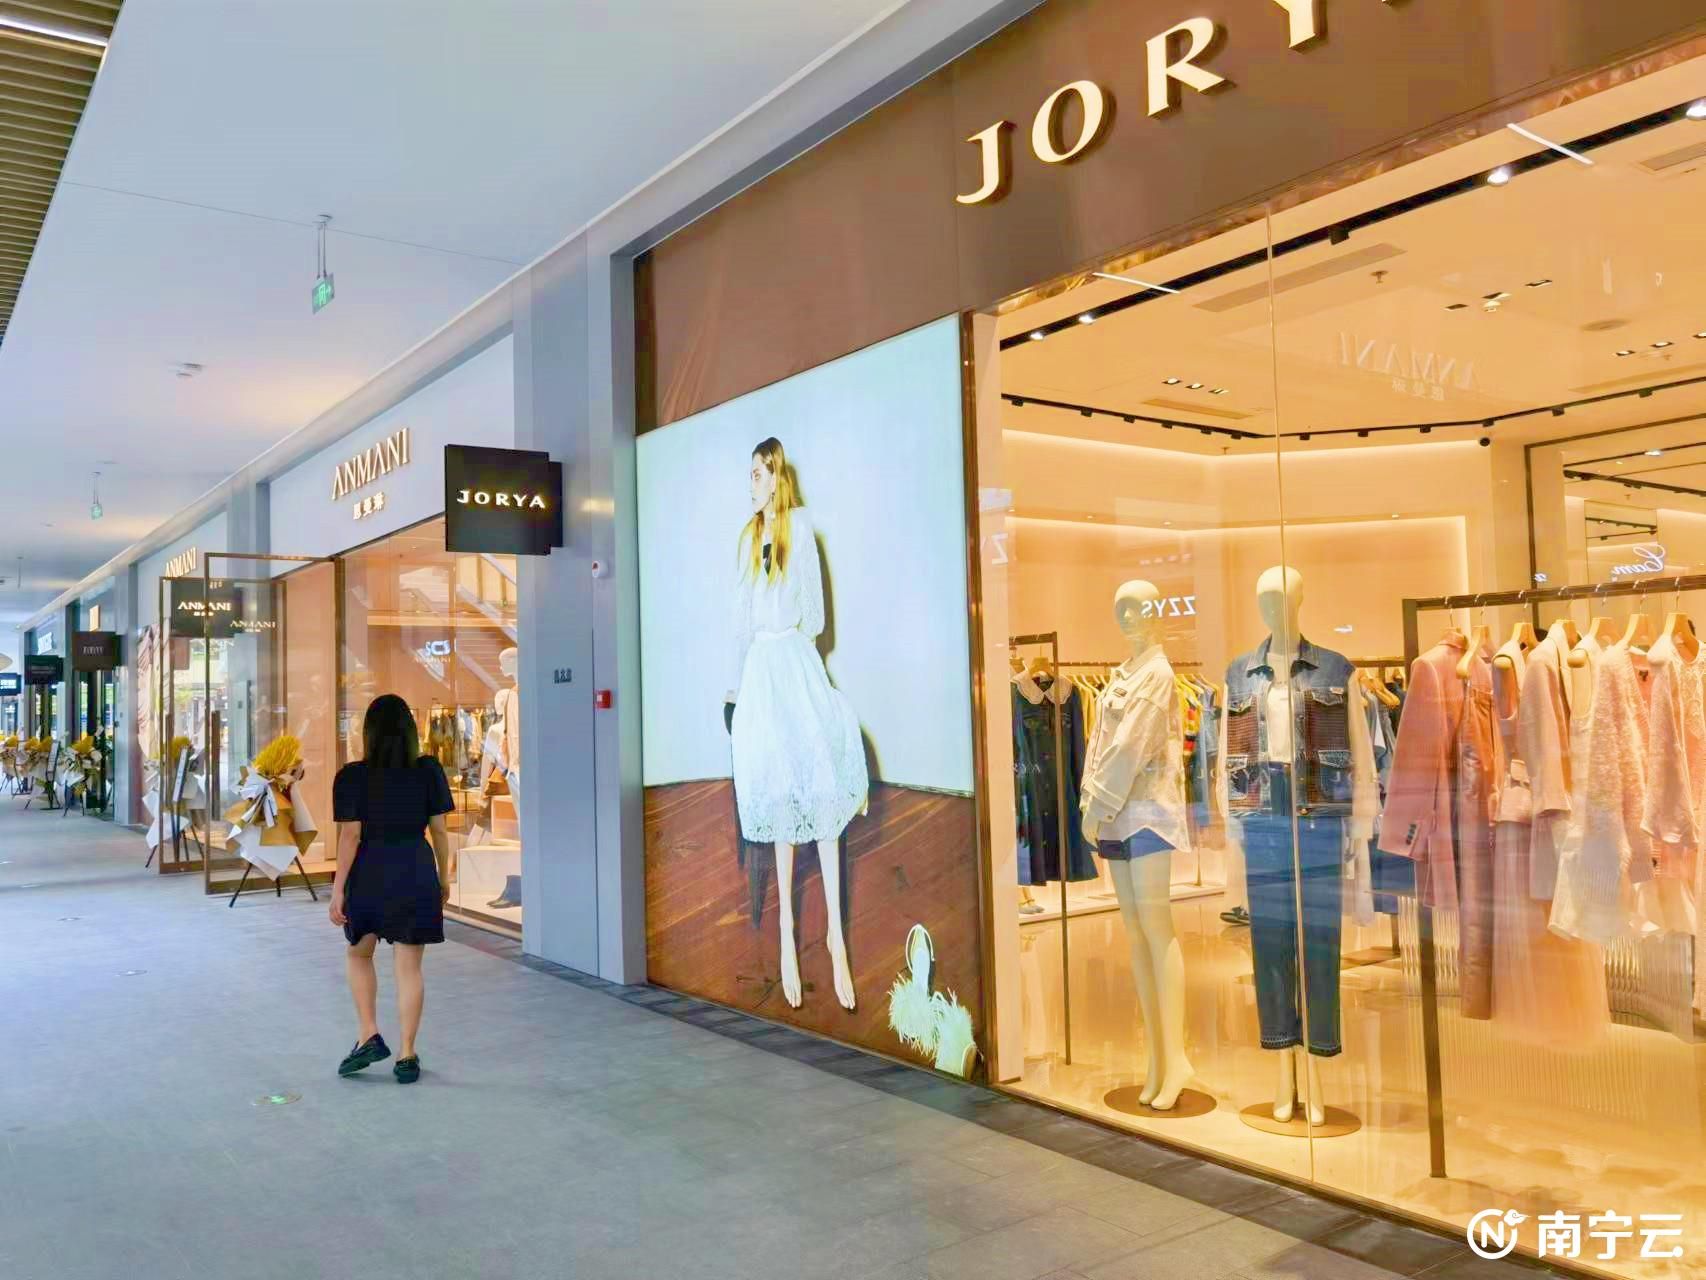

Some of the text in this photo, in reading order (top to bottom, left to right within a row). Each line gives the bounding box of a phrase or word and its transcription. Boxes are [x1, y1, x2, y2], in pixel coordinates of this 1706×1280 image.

[957, 0, 1392, 204] JORY
[332, 428, 409, 500] ANMANI
[457, 490, 546, 509] JORYA
[165, 547, 196, 577] ANMANI
